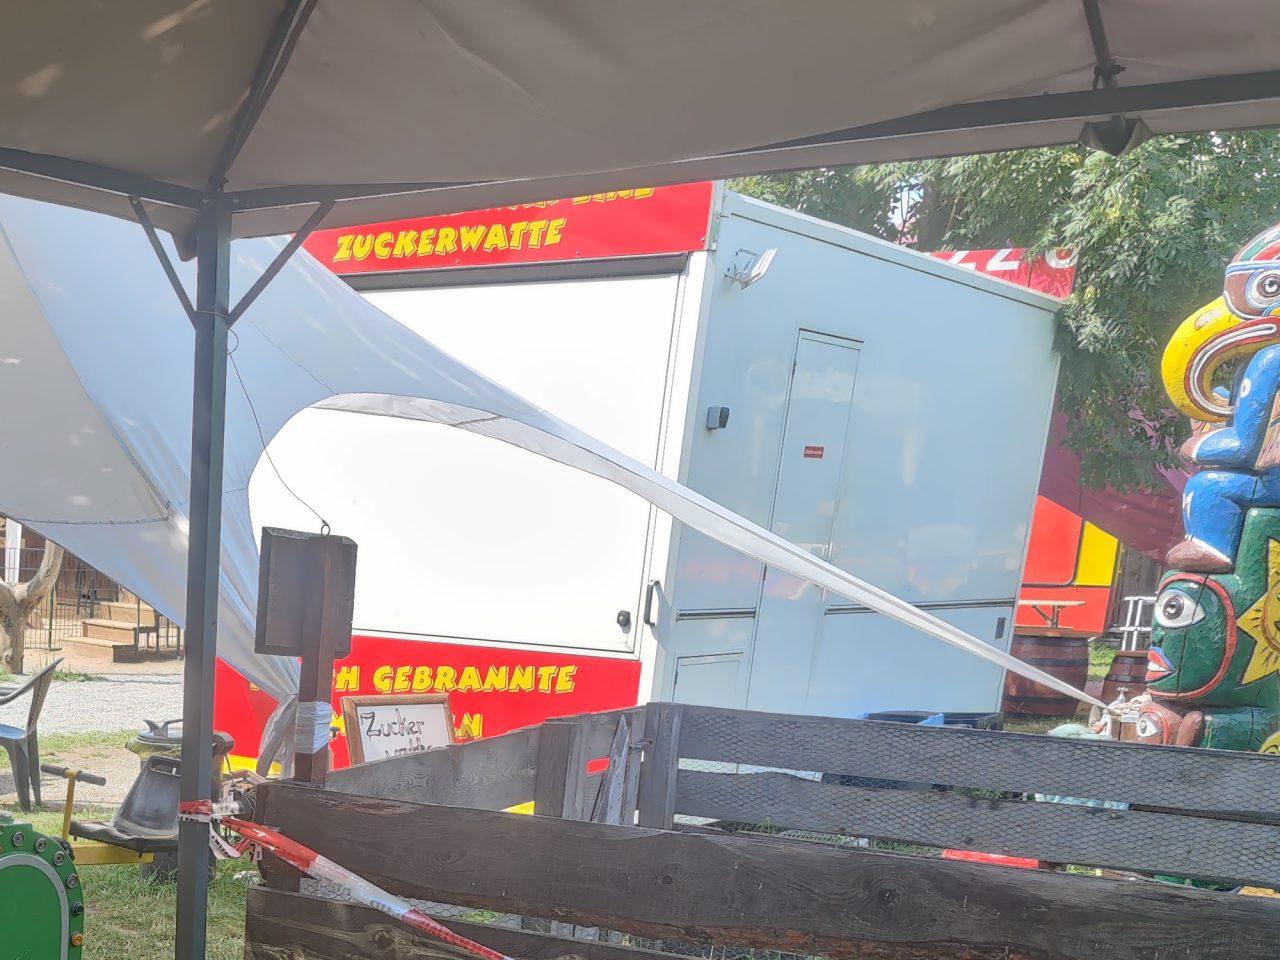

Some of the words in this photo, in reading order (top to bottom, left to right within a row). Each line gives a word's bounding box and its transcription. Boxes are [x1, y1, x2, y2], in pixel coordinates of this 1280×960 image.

[332, 217, 566, 262] ZUCKERWATTE
[373, 665, 578, 694] GEBRANNTE
[360, 708, 425, 741] Zucker
